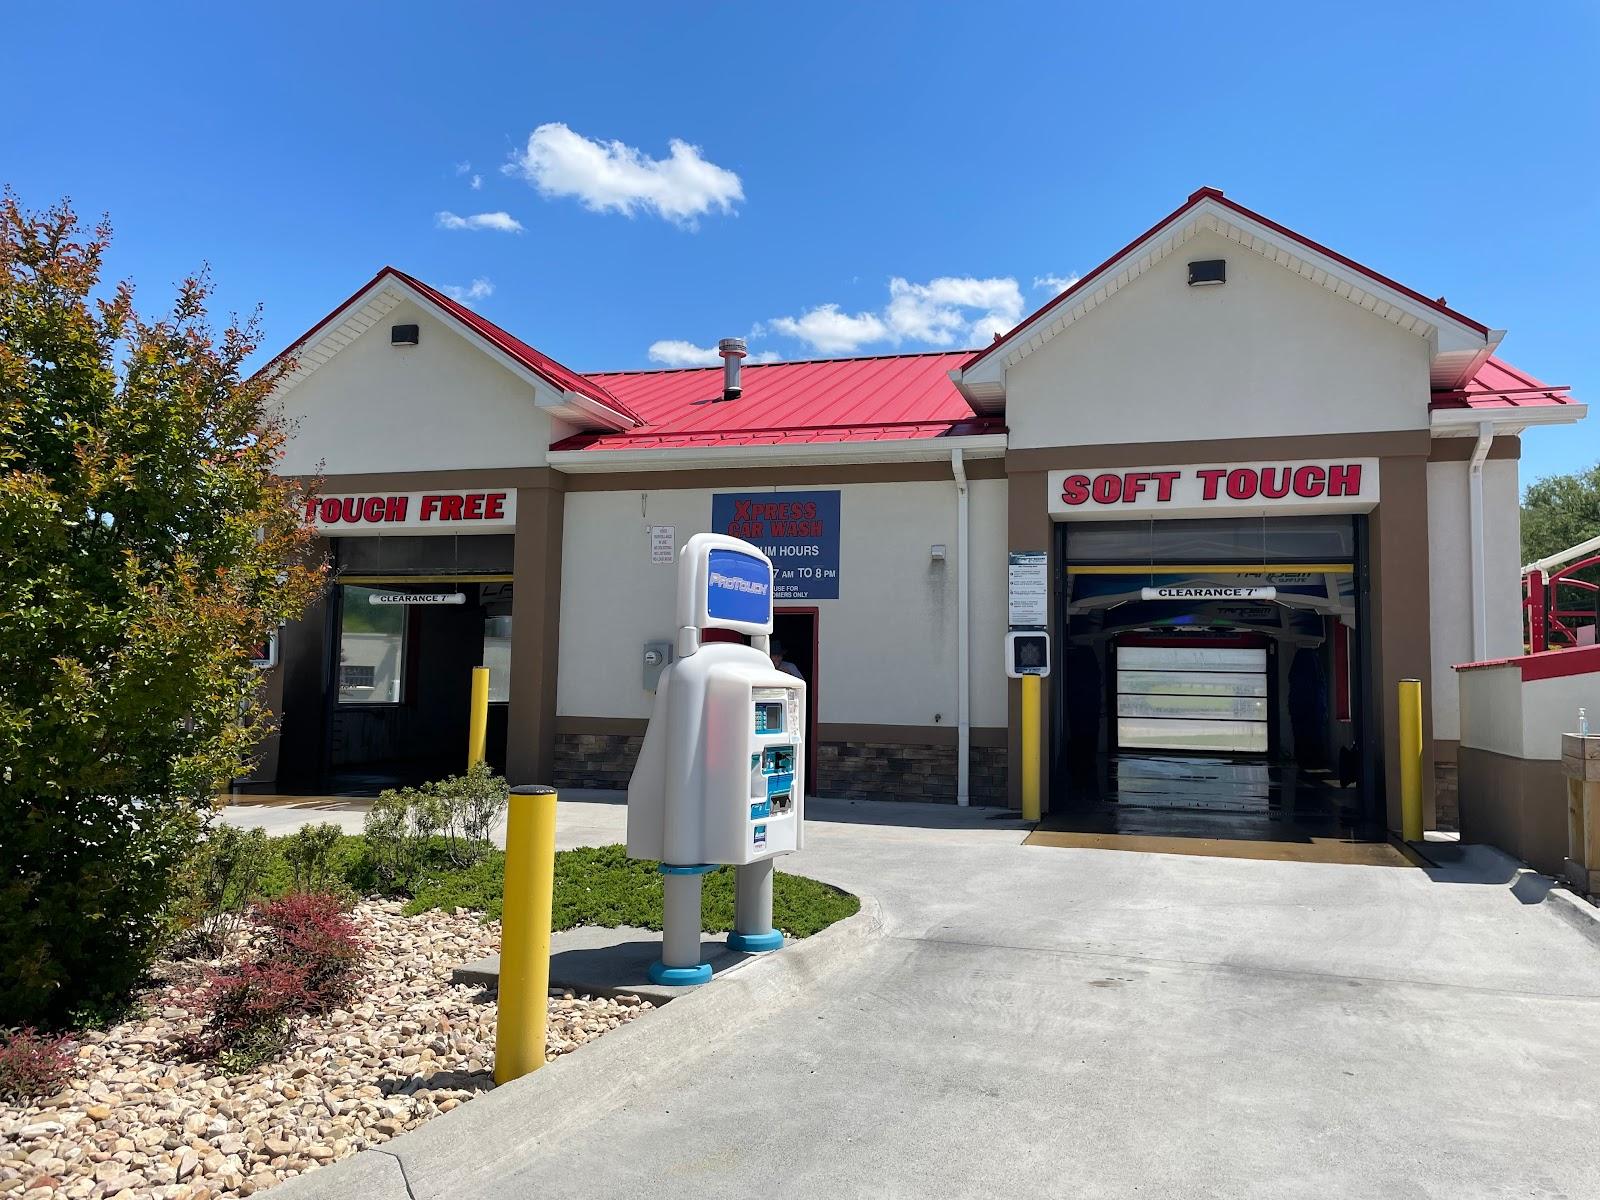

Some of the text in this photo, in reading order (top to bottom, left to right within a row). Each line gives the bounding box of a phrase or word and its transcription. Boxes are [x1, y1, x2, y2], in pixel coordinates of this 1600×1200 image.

[1061, 464, 1362, 505] SOFT TOUCH
[304, 493, 507, 524] TOUCH FREE
[734, 500, 817, 521] XPRESS
[727, 520, 824, 538] CAR WASH
[779, 545, 820, 556] HOURS
[773, 567, 836, 579] 7 AM TO 8 PM
[1158, 588, 1258, 597] CLEARANCE 7'
